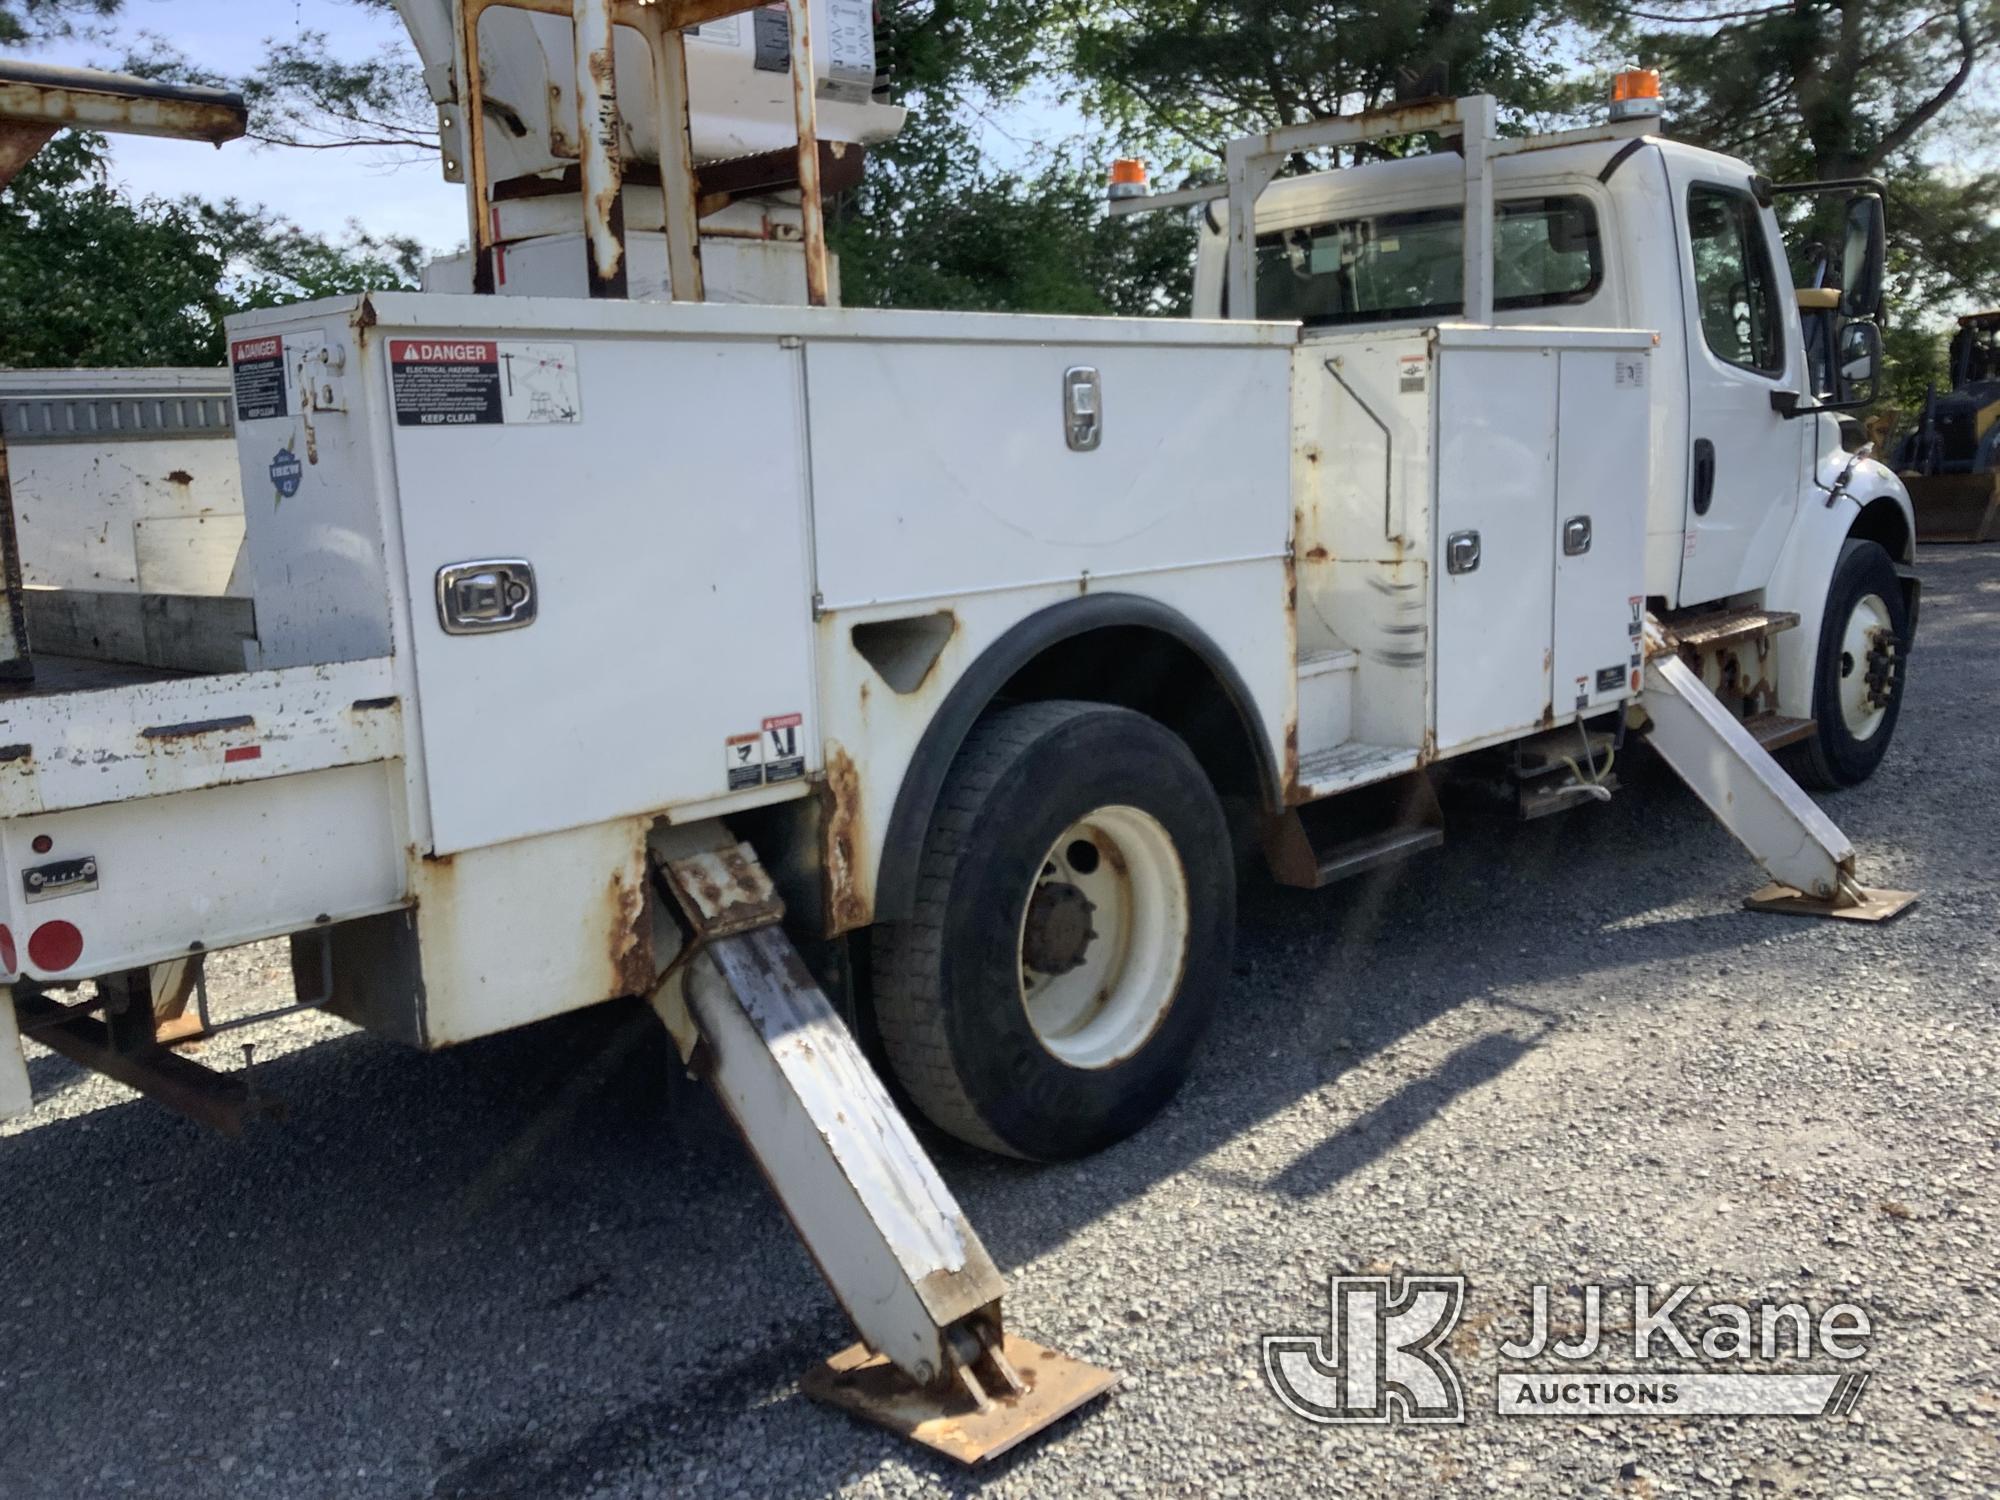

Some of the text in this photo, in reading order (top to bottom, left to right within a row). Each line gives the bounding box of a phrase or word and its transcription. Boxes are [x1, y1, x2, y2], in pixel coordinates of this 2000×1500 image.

[421, 345, 486, 360] DANGER
[406, 366, 447, 374] ELECTRICAL
[421, 414, 476, 423] KEEP CLEAR
